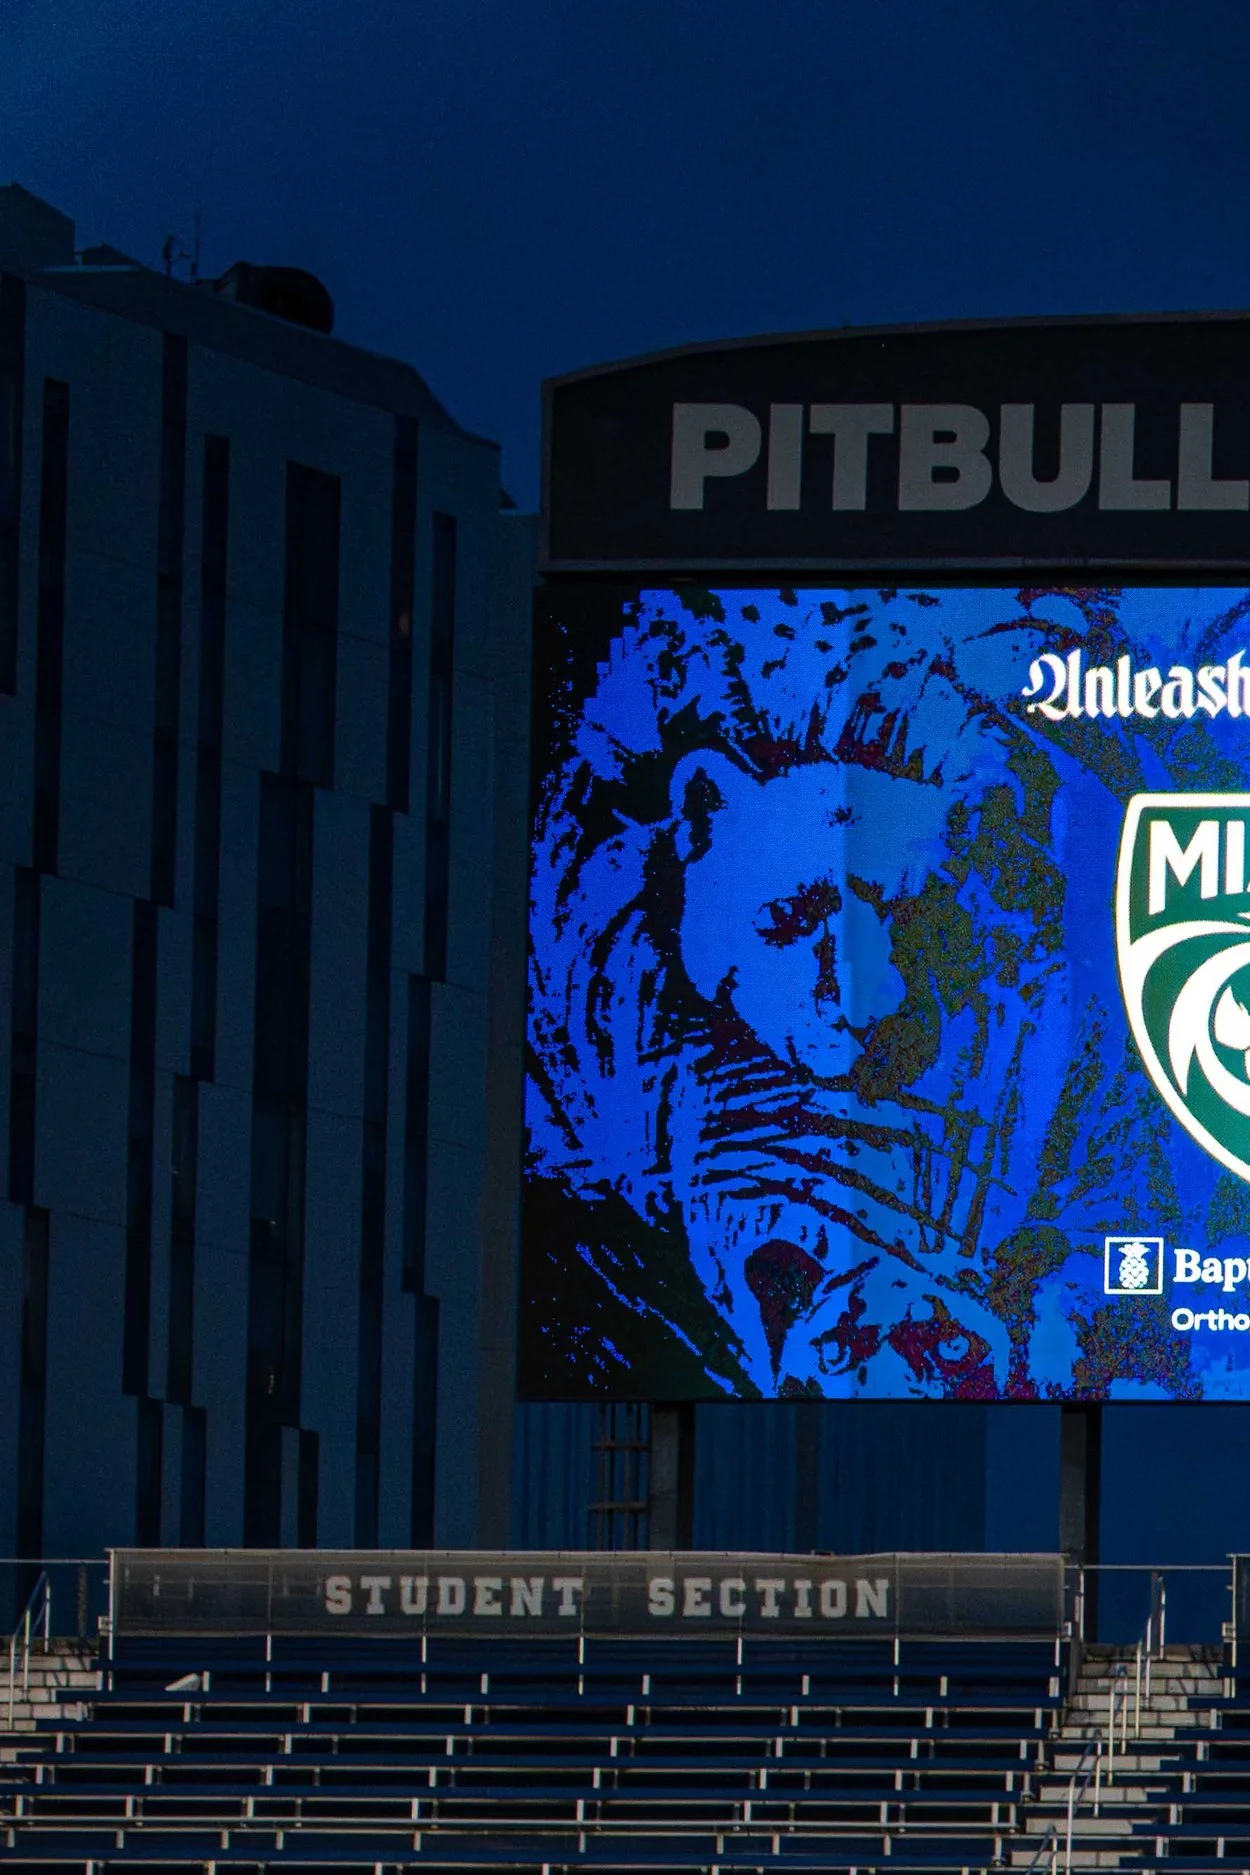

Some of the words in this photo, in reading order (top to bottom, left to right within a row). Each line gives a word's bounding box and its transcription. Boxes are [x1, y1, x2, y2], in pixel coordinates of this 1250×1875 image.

[670, 401, 1250, 514] PITBULL
[325, 1575, 587, 1618] STUDENT
[648, 1576, 890, 1619] SECTION
